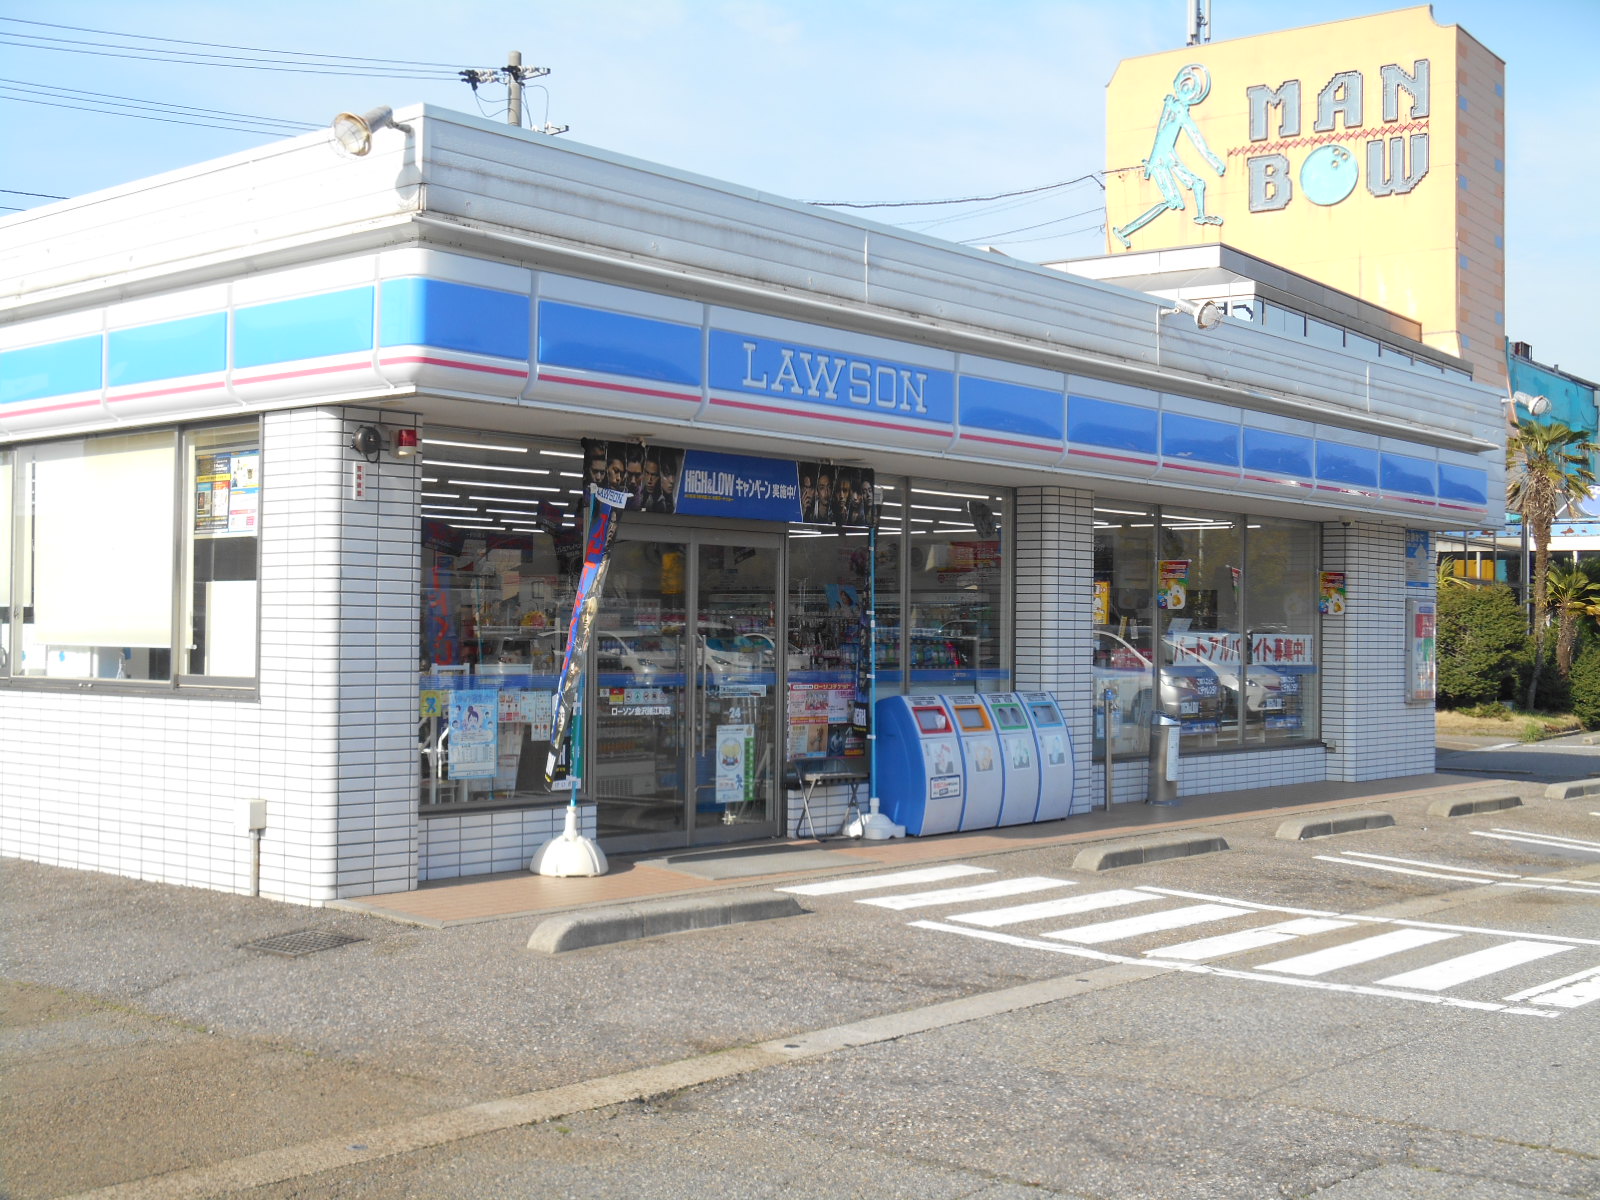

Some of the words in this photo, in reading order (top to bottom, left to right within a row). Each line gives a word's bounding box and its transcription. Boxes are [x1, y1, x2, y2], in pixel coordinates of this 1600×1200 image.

[1246, 59, 1429, 142] MAN
[742, 342, 927, 414] LAWSON
[729, 707, 741, 719] 24
